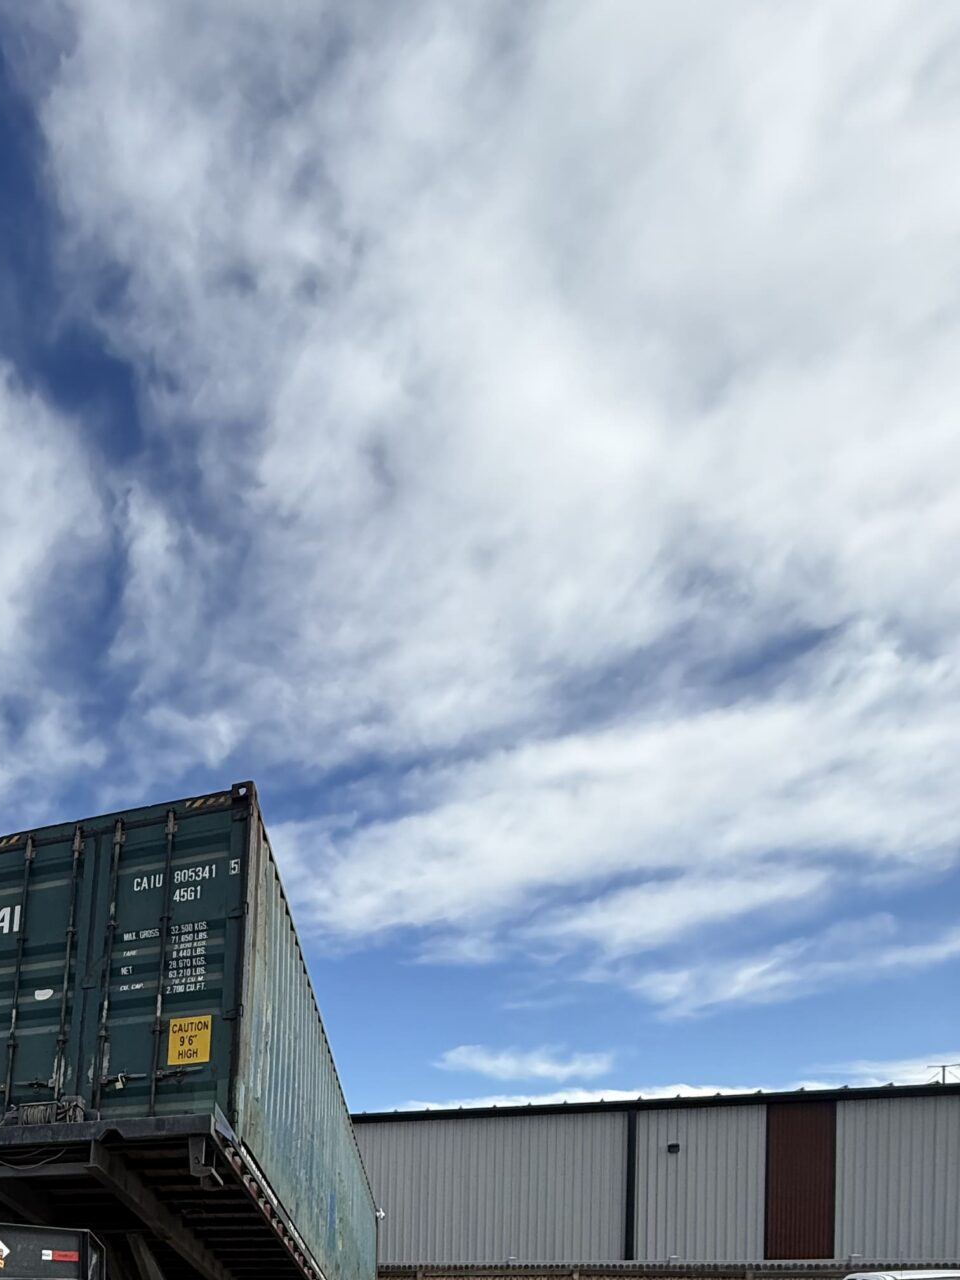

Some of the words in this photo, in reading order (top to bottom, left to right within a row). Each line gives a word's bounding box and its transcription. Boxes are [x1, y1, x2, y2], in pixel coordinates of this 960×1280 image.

[133, 874, 164, 891] CAIU
[174, 864, 216, 884] 805341
[230, 859, 239, 874] 5
[173, 885, 201, 902] 45G1
[123, 932, 139, 942] MAX.
[139, 928, 160, 939] GROSS
[170, 923, 193, 934] 32.500
[194, 921, 209, 930] KGS.
[194, 931, 209, 940] LBS.
[192, 947, 207, 956] LBS.
[120, 966, 133, 976] NET
[168, 958, 191, 969] 28.670
[192, 957, 207, 966] KGS.
[192, 966, 207, 976] LBS.
[171, 1020, 209, 1034] CAUTION
[177, 1048, 199, 1060] HIGH
